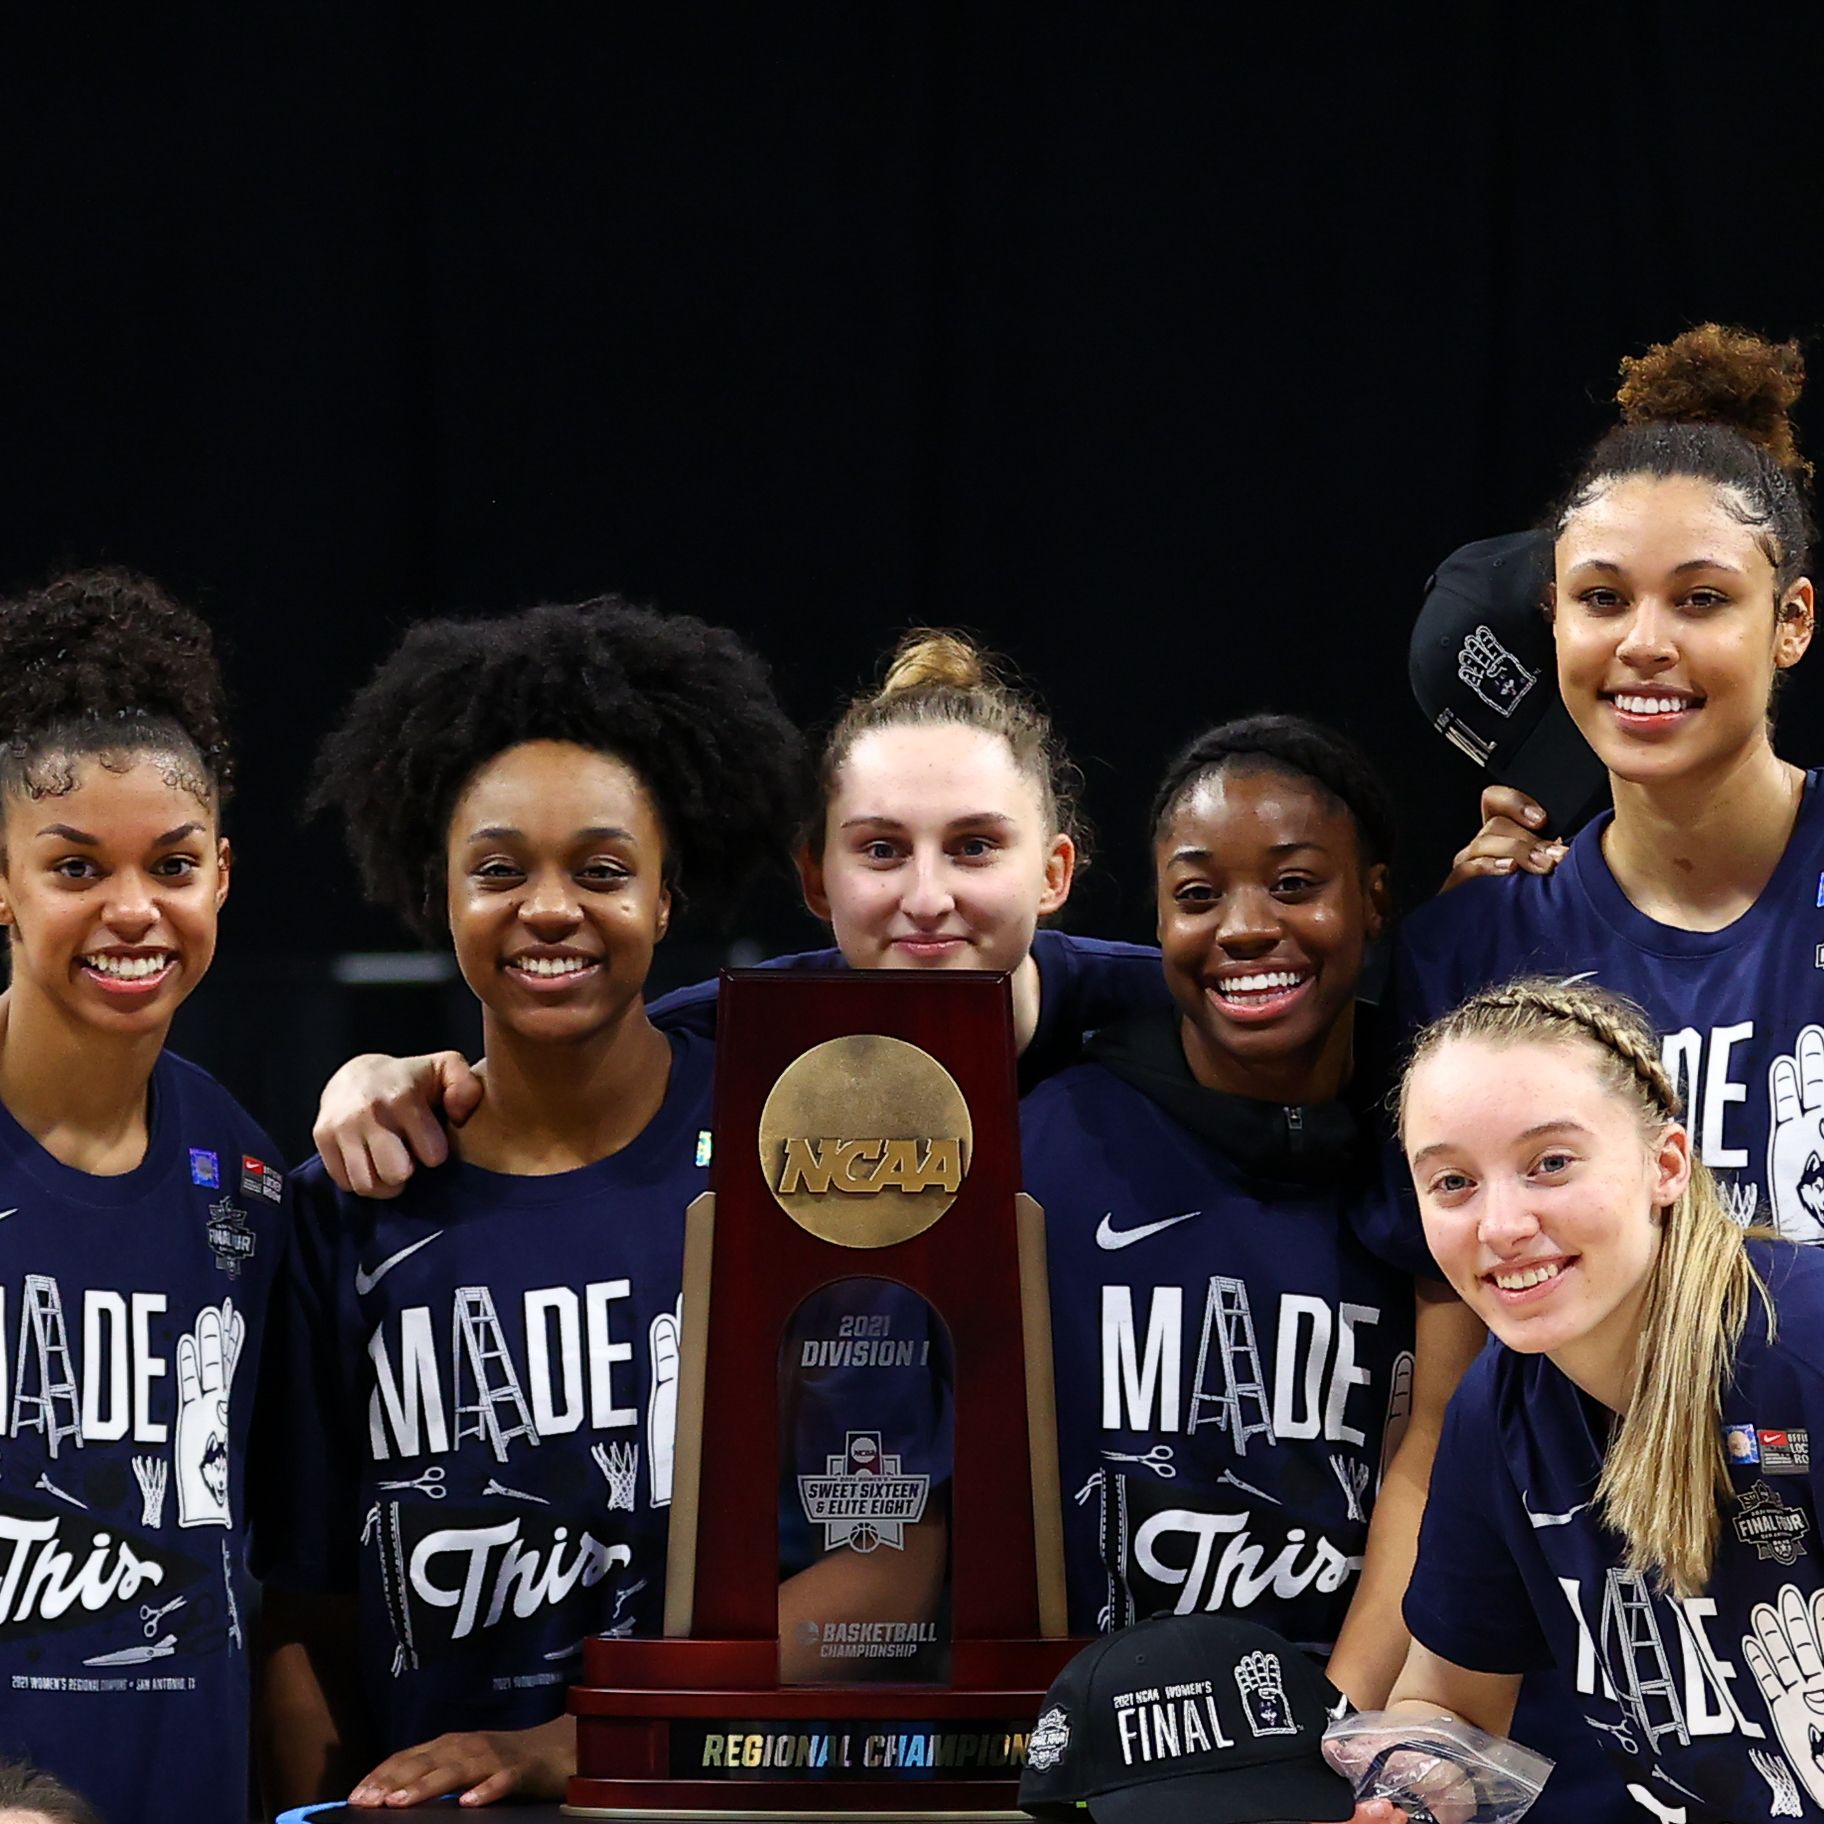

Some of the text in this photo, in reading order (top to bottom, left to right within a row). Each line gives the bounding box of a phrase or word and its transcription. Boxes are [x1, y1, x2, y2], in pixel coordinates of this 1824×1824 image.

[778, 1136, 962, 1194] NCAA
[838, 1315, 890, 1338] 2021
[801, 1340, 930, 1369] DIVISION I
[1101, 1275, 1381, 1456] MADE
[368, 1278, 638, 1463] MADE
[808, 1483, 920, 1498] SWEET SIXTEEN
[816, 1500, 914, 1514] & ELITE EIGHT
[1738, 1515, 1778, 1537] FINAL
[1134, 1509, 1363, 1615] This
[410, 1517, 632, 1639] This
[821, 1621, 937, 1644] BASKETBALL
[820, 1644, 918, 1659] CHAMPIONSHIP
[30, 1677, 67, 1690] WOMEN'S
[136, 1678, 150, 1691] SAN
[1113, 1681, 1213, 1709] 2021 NCAA WOMEN'S
[1117, 1696, 1235, 1766] FINAL
[702, 1732, 1032, 1769] REGIONAL CHAMPION
